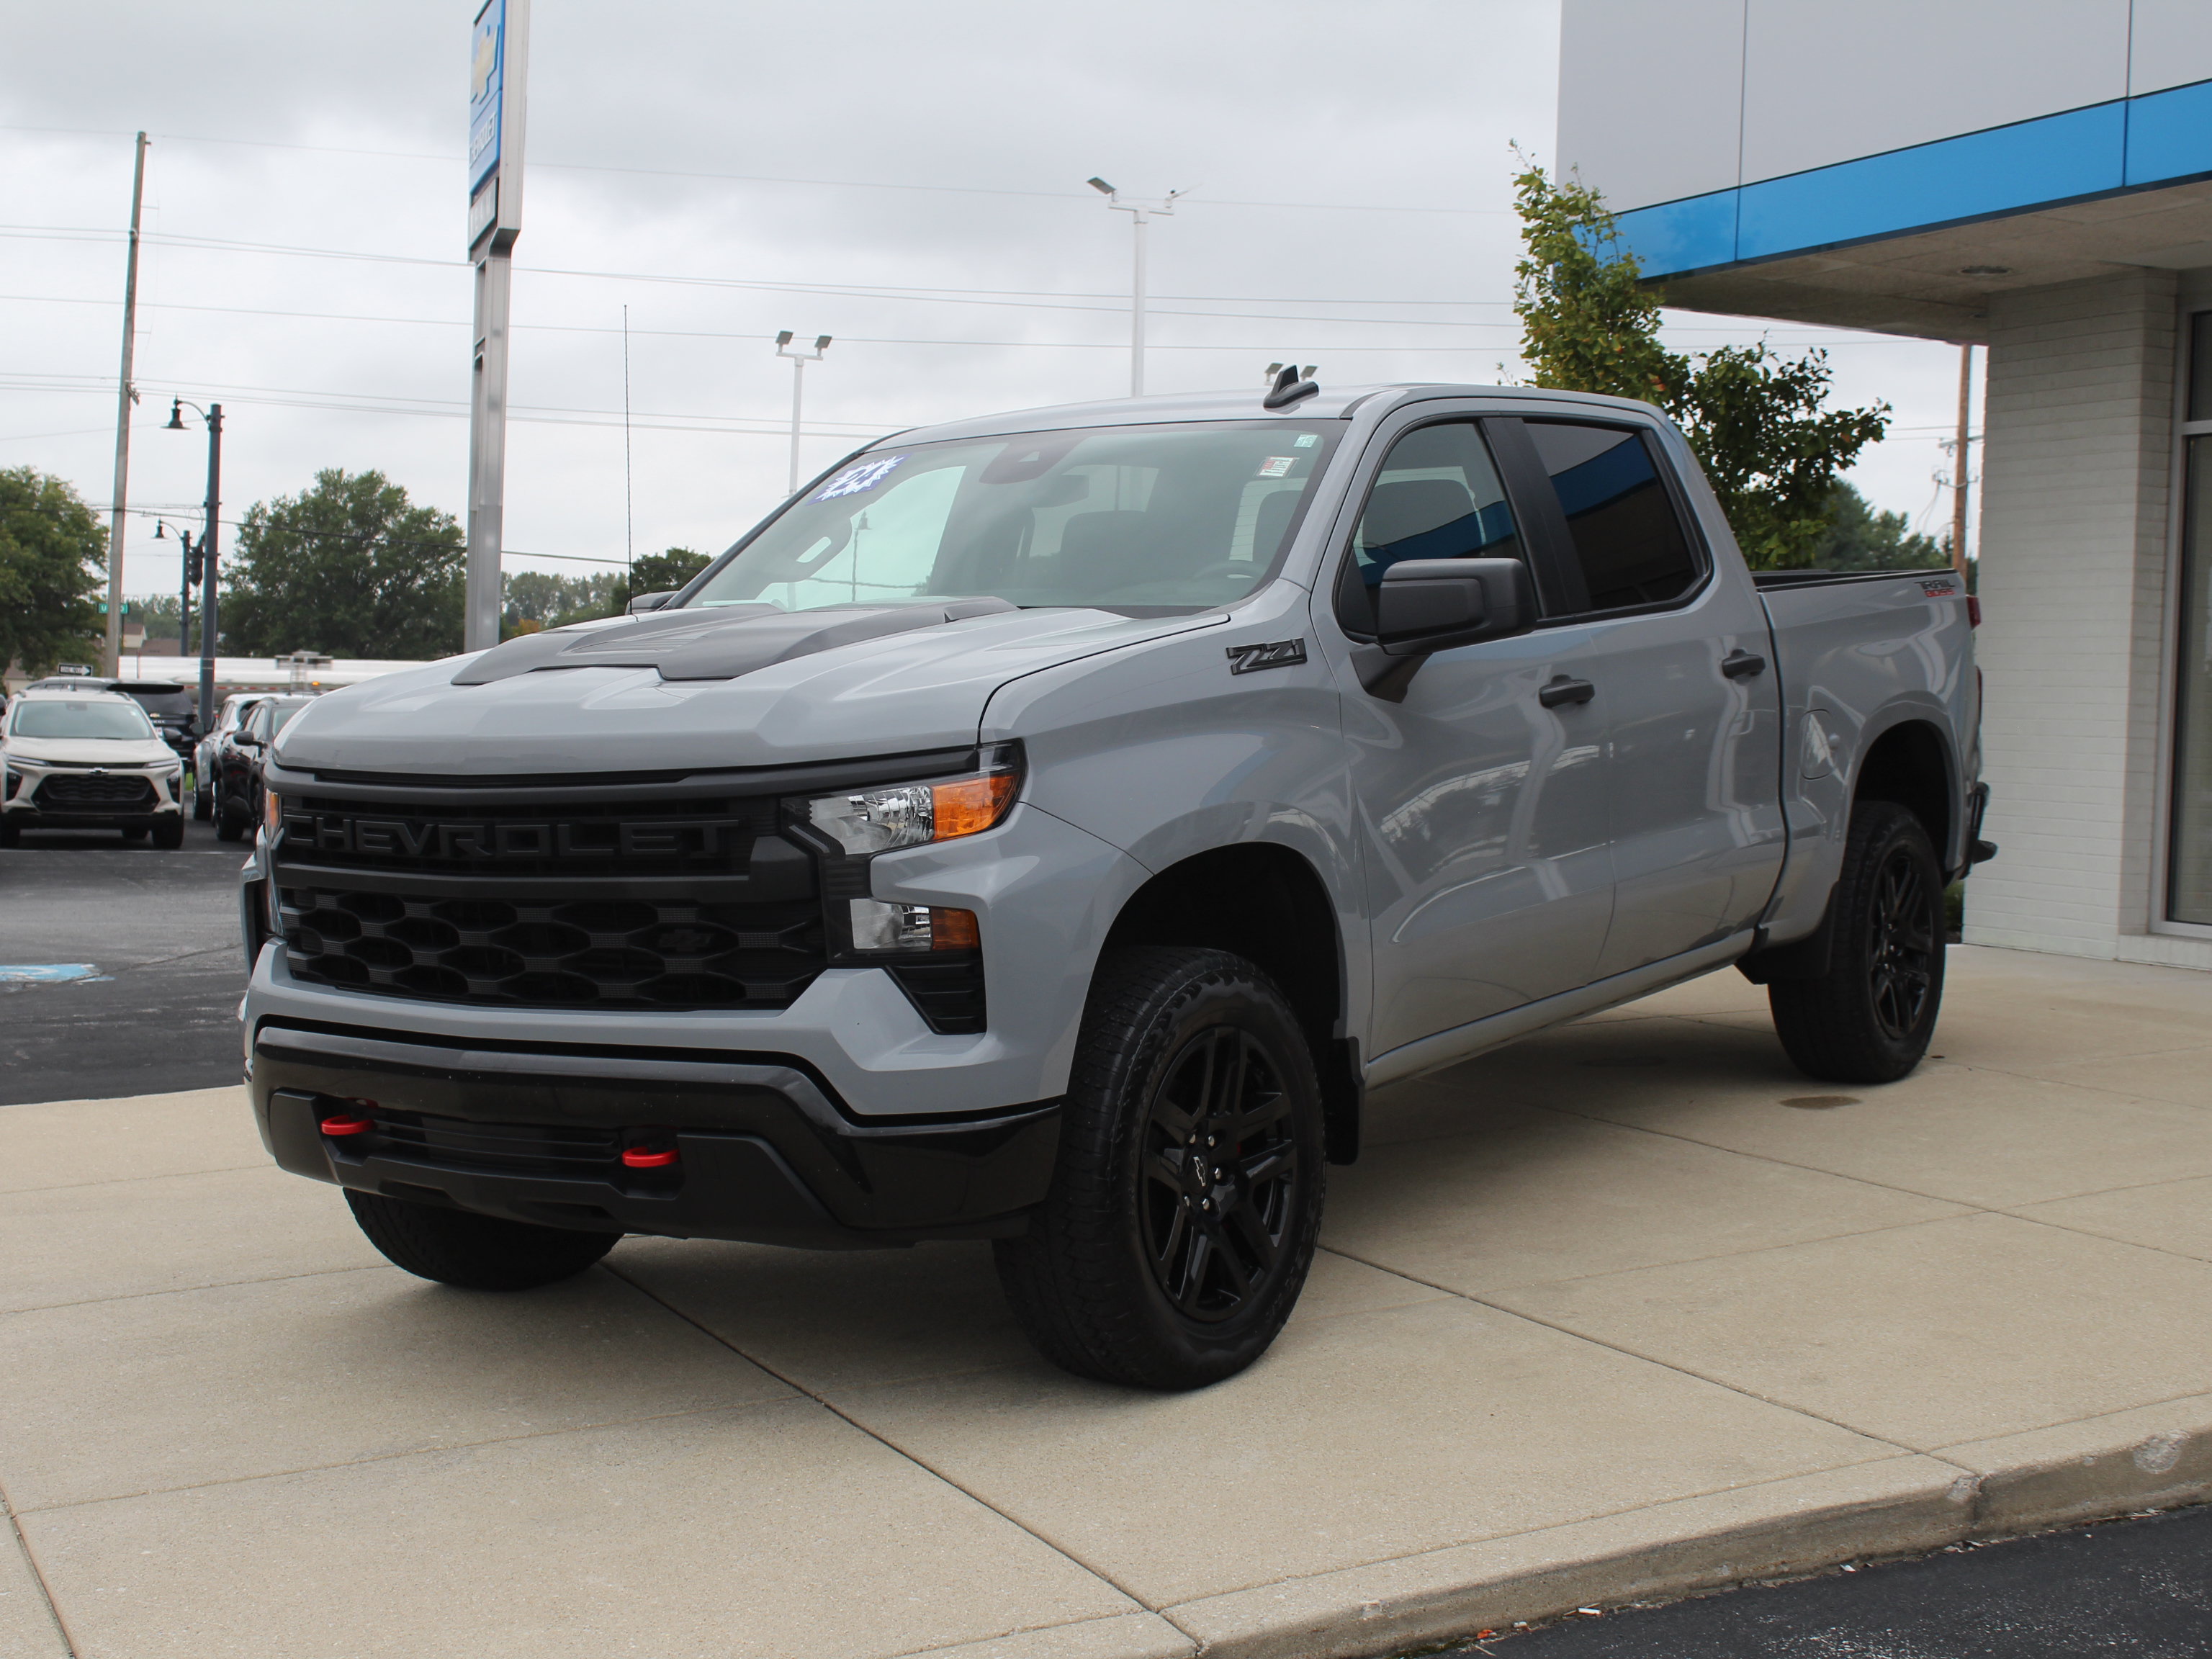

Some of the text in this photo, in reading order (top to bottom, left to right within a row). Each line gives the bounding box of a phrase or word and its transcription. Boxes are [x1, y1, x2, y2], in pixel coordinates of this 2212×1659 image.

[1914, 579, 1956, 590] TRAIL
[1924, 588, 1956, 598] BOSS
[1226, 637, 1308, 675] Z71
[282, 814, 740, 857] CHEVROLET
